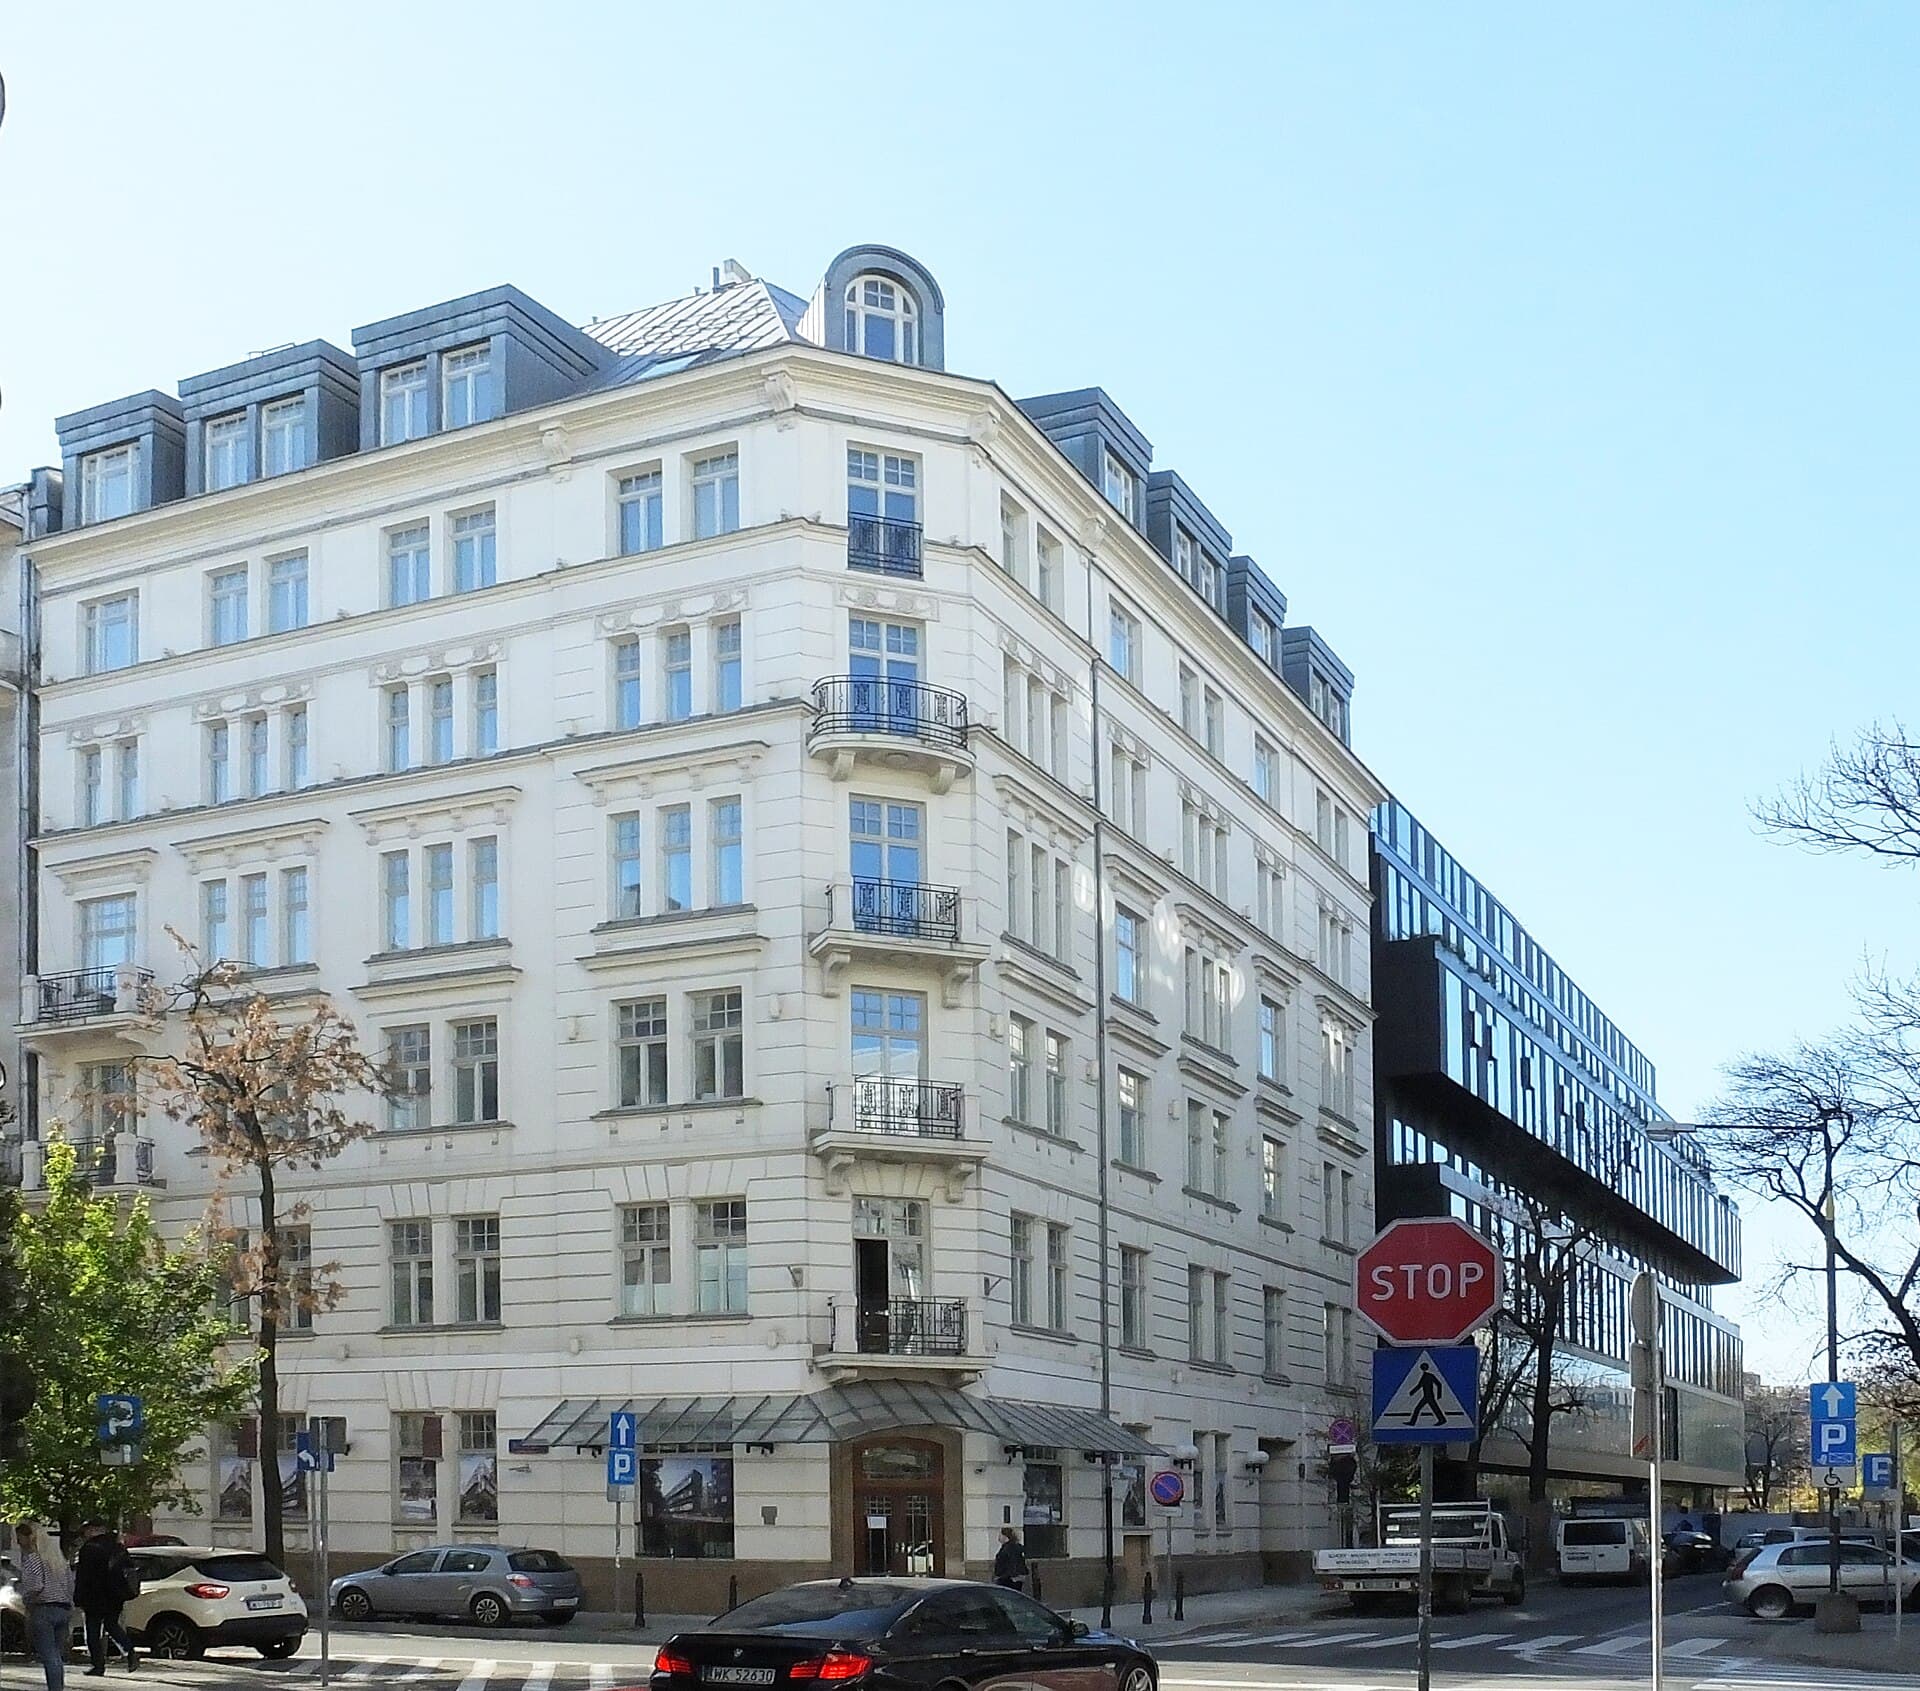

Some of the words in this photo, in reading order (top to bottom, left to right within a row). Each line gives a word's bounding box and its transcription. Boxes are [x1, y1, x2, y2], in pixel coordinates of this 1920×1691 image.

[1371, 1262, 1484, 1301] STOP
[107, 1400, 134, 1436] P
[1821, 1423, 1847, 1453] P
[614, 1453, 631, 1481] P
[1872, 1457, 1893, 1482] P
